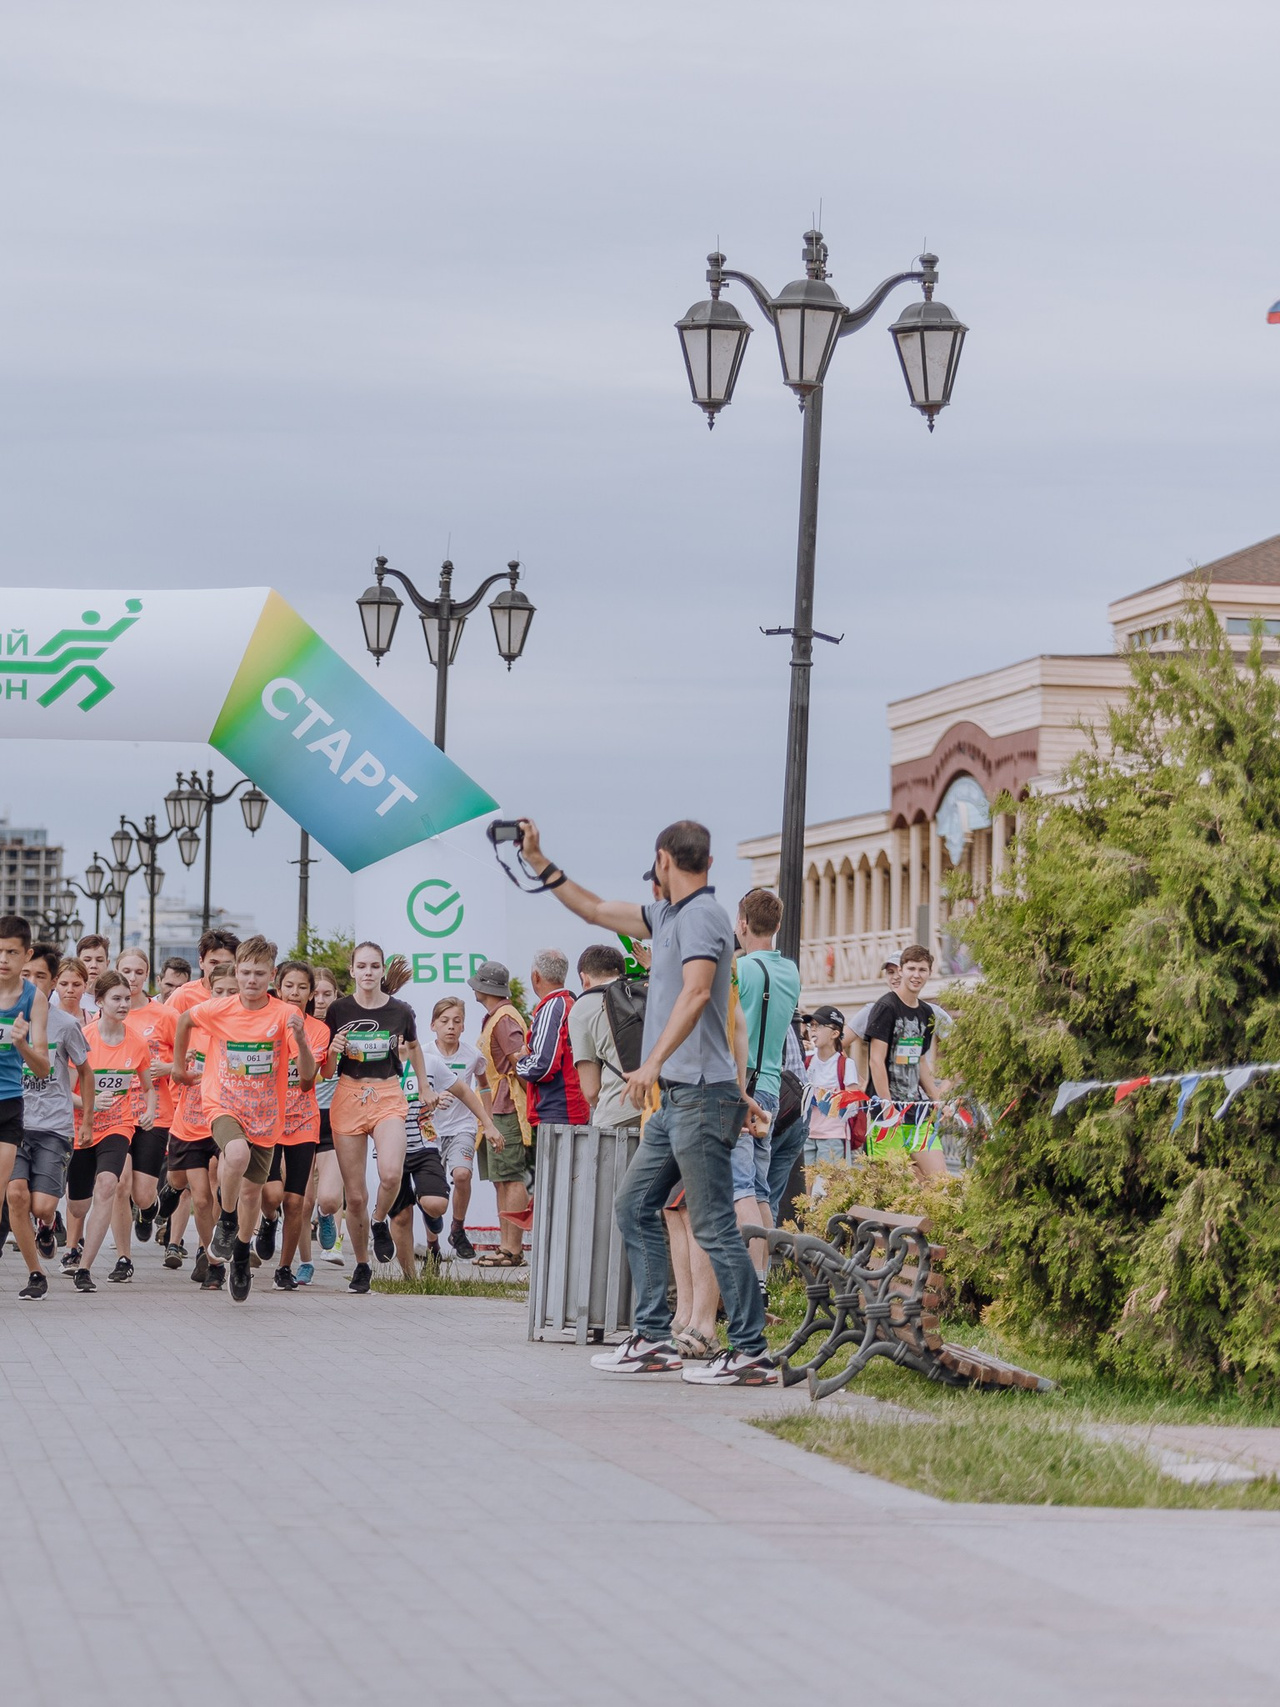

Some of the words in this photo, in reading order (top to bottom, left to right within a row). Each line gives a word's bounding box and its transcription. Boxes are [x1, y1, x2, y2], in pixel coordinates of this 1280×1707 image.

[261, 677, 419, 817] СТАРТ
[246, 1054, 261, 1062] 061
[98, 1077, 123, 1088] 628
